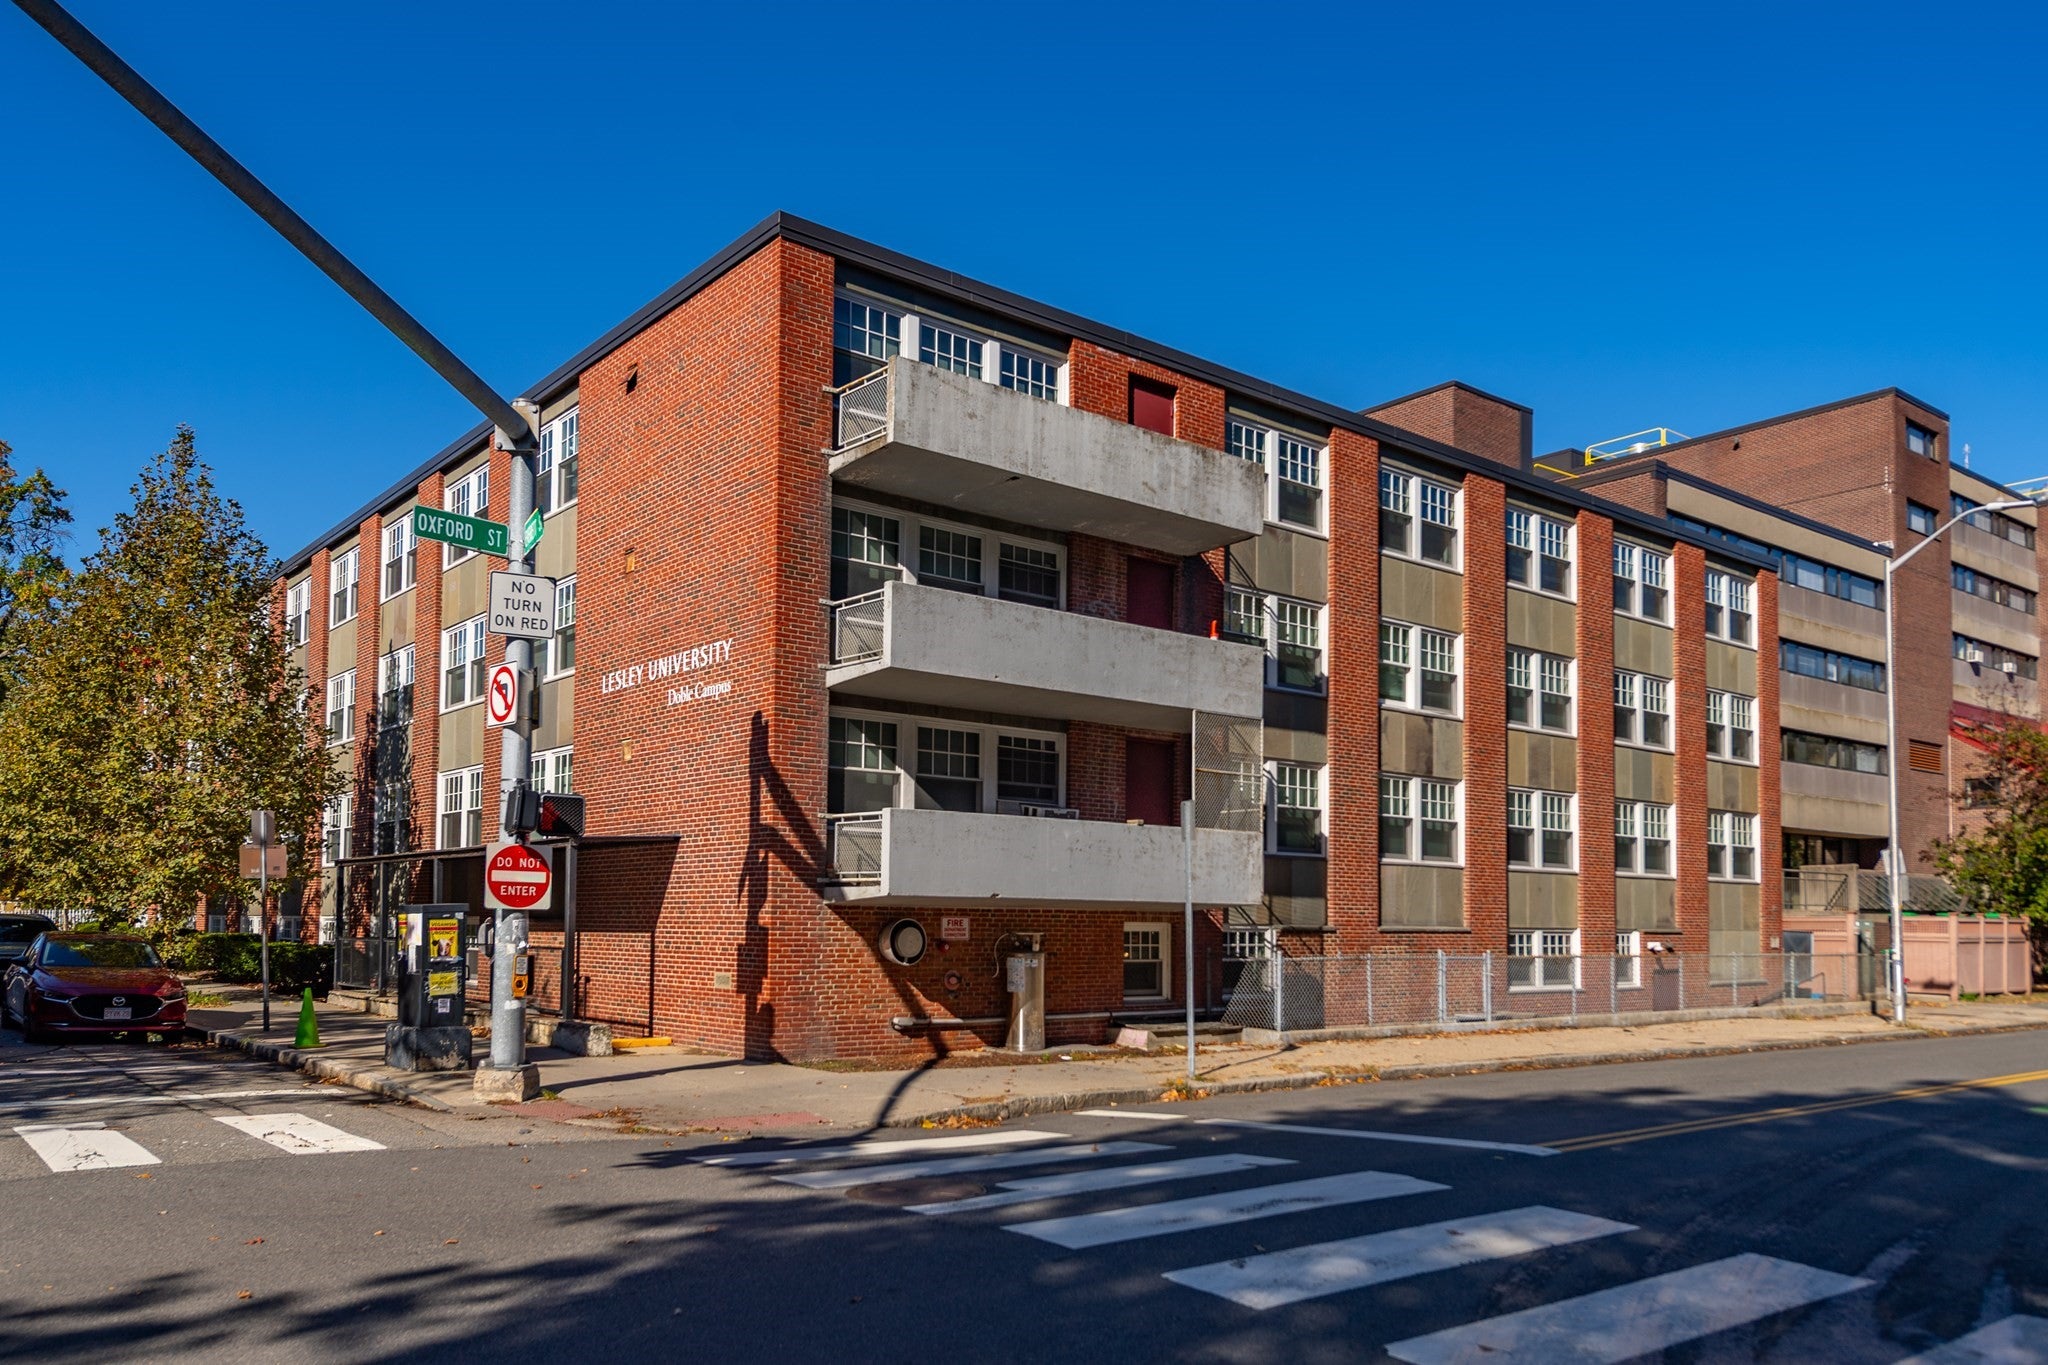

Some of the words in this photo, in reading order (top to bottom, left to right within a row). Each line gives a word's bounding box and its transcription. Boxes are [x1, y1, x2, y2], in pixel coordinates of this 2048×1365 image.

[418, 513, 474, 541] OXFORD
[487, 529, 502, 548] ST
[511, 581, 535, 595] NO
[503, 597, 542, 613] TURN
[495, 614, 515, 628] ON
[521, 617, 548, 631] RED
[602, 664, 645, 694] LESLEY
[648, 637, 734, 681] UNIVERSITY
[667, 685, 693, 706] Doble
[694, 680, 732, 701] Campus
[496, 856, 513, 867] DO
[519, 857, 542, 868] NOT
[500, 885, 537, 896] ENTER
[946, 919, 964, 927] FIRE
